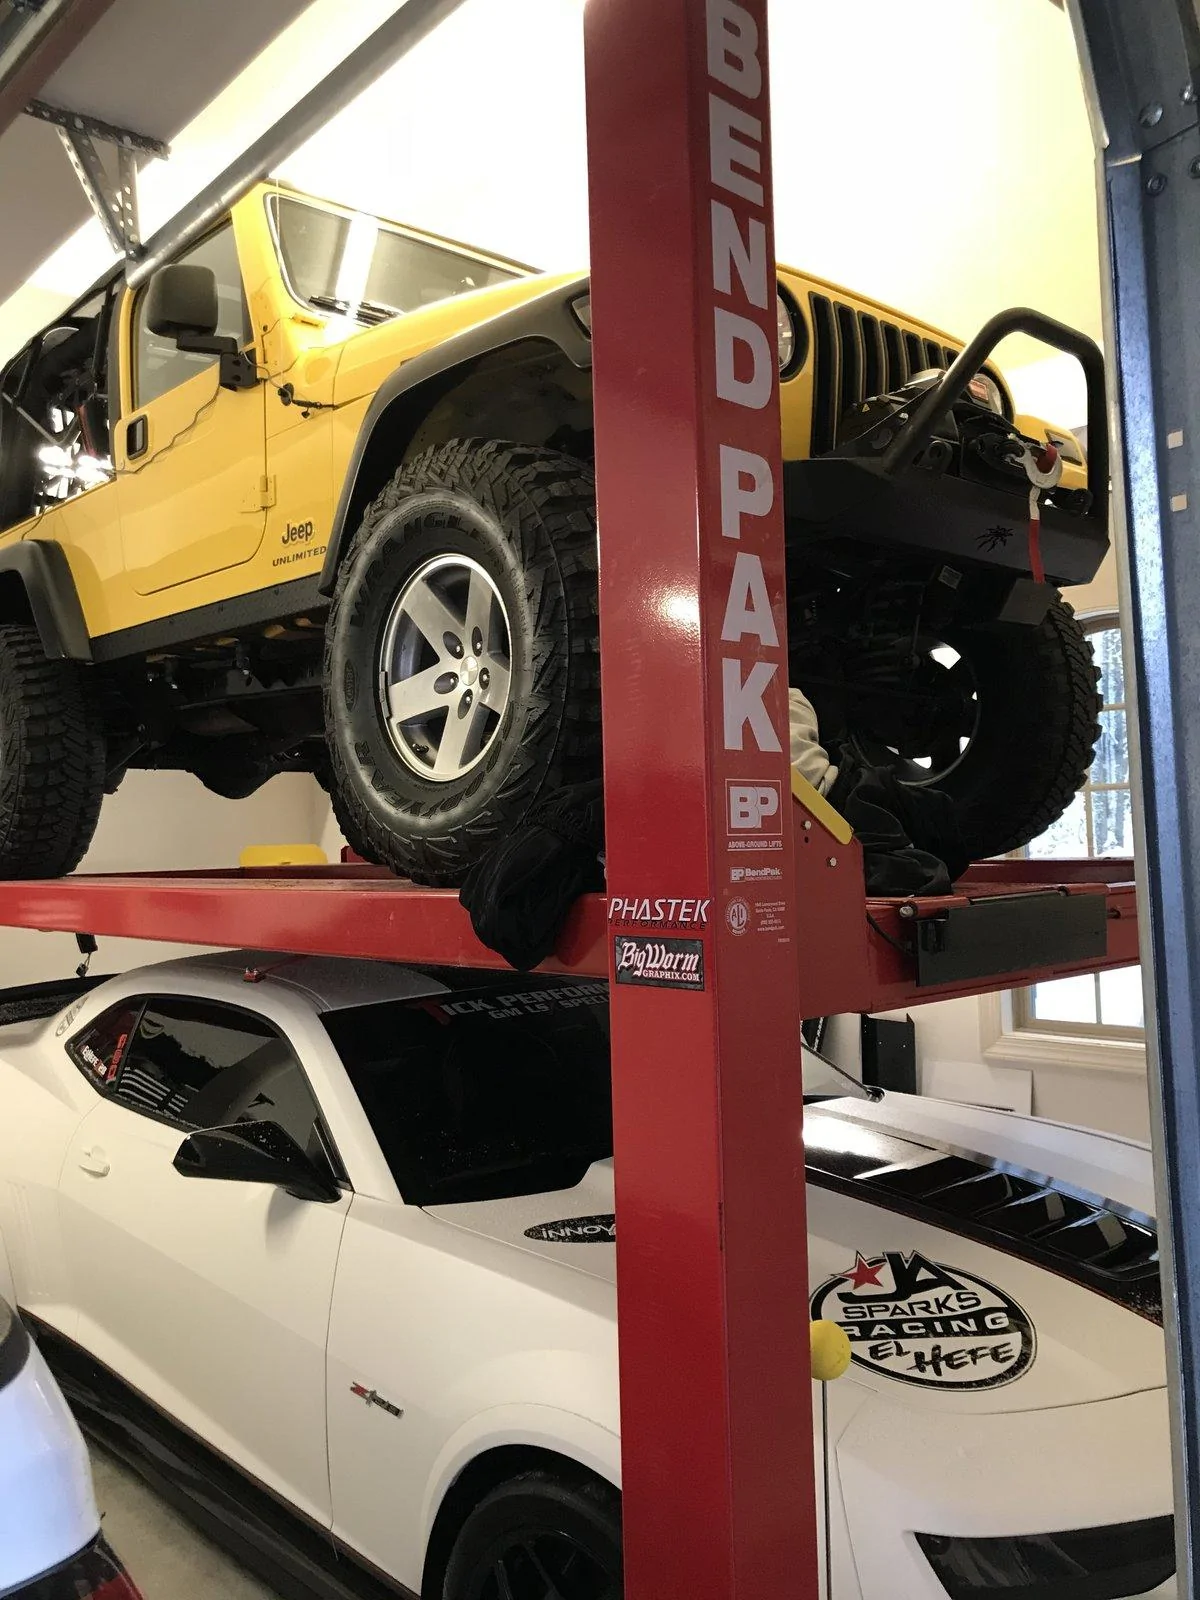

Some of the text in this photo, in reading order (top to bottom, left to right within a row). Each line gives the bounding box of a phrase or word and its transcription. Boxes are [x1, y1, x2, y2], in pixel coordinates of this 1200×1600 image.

[281, 521, 313, 545] Jeep
[272, 545, 327, 567] UNLIMITED
[729, 785, 778, 829] BP
[745, 867, 781, 877] BendPak
[608, 898, 711, 922] PHASTEK
[642, 970, 700, 982] GRAPHIX.COM
[488, 1007, 523, 1020] GM
[842, 1291, 982, 1320] SPARKS
[841, 1311, 1010, 1338] RACING
[867, 1340, 1016, 1377] EL HEFE
